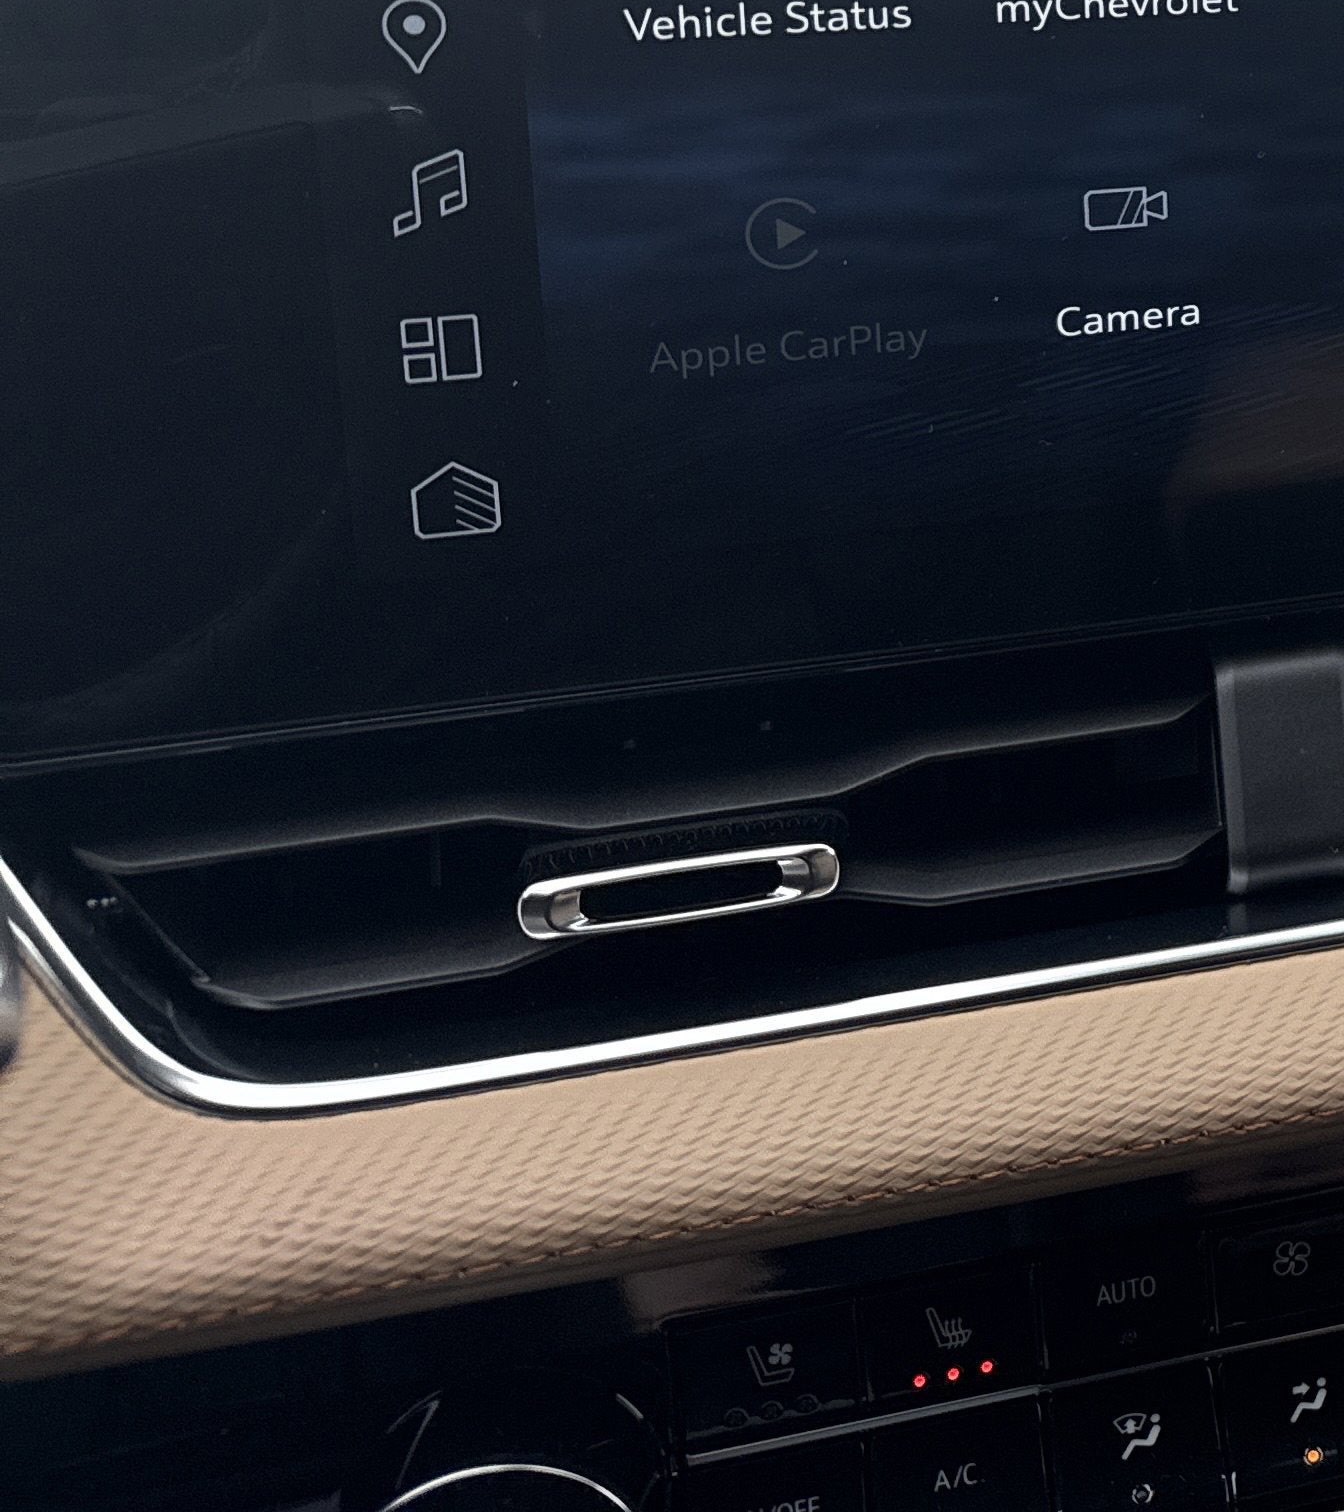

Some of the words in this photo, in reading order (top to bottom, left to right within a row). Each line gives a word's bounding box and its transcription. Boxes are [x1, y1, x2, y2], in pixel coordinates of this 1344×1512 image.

[623, 1, 773, 41] Vehicle
[786, 0, 913, 34] Status
[1056, 303, 1201, 337] Camera
[649, 334, 767, 380] Apple
[779, 322, 928, 361] CarPlay
[1096, 1275, 1157, 1307] AUTO
[933, 1462, 979, 1492] A/C
